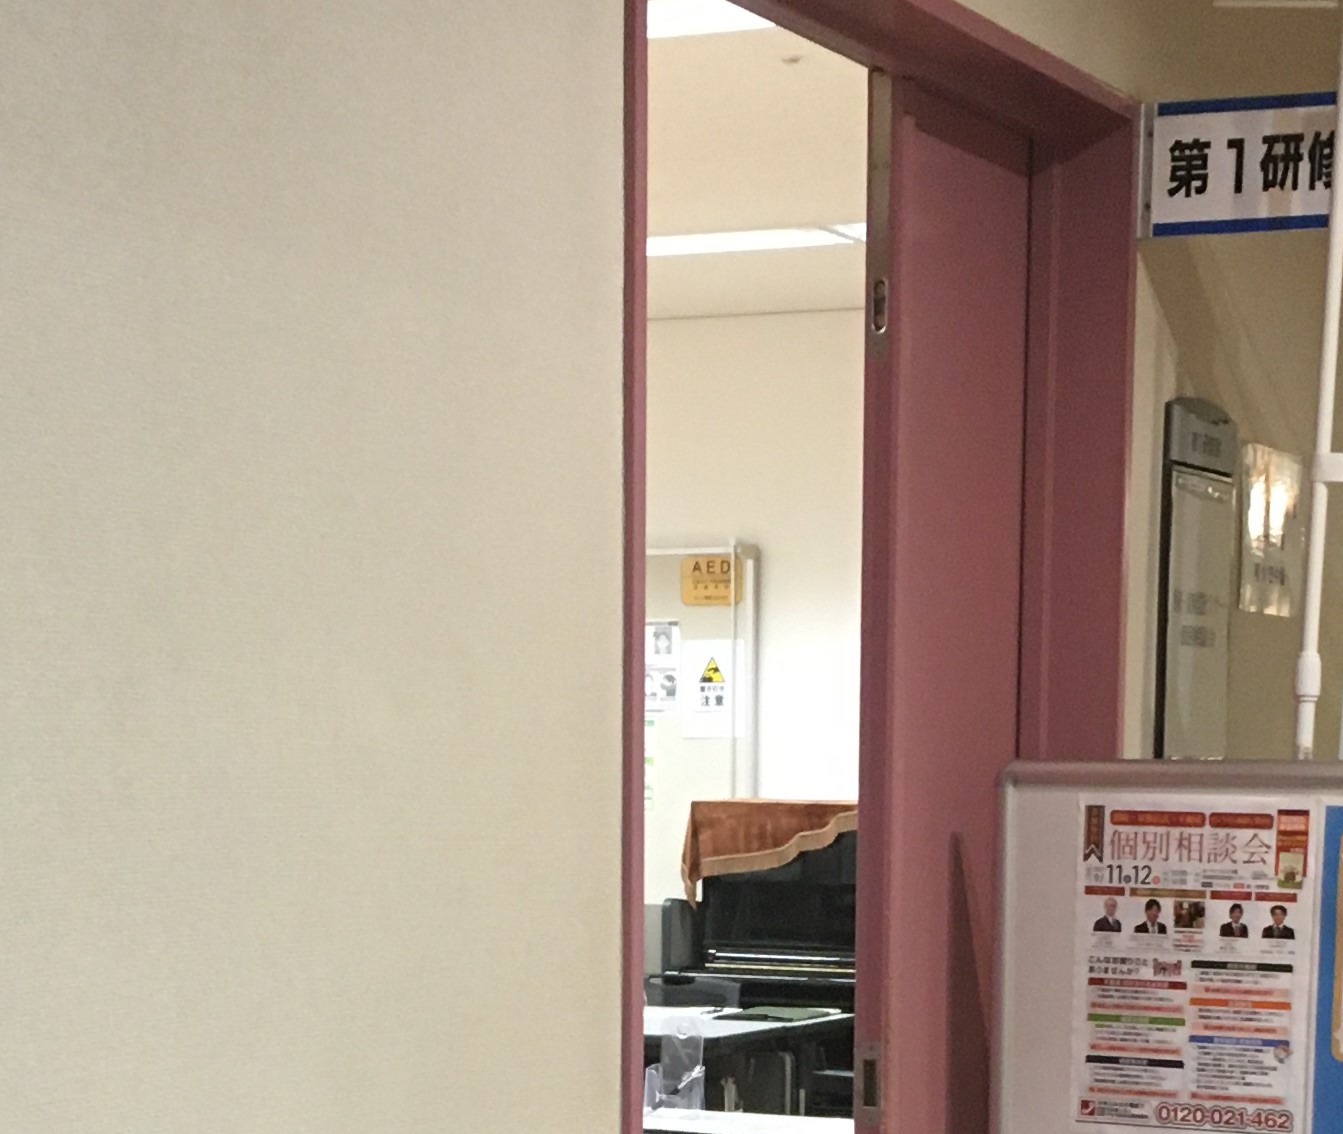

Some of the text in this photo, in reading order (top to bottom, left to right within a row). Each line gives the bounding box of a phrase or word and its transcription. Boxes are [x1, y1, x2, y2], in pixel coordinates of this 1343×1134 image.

[692, 560, 731, 575] AED
[1108, 829, 1272, 865] 個別相談会
